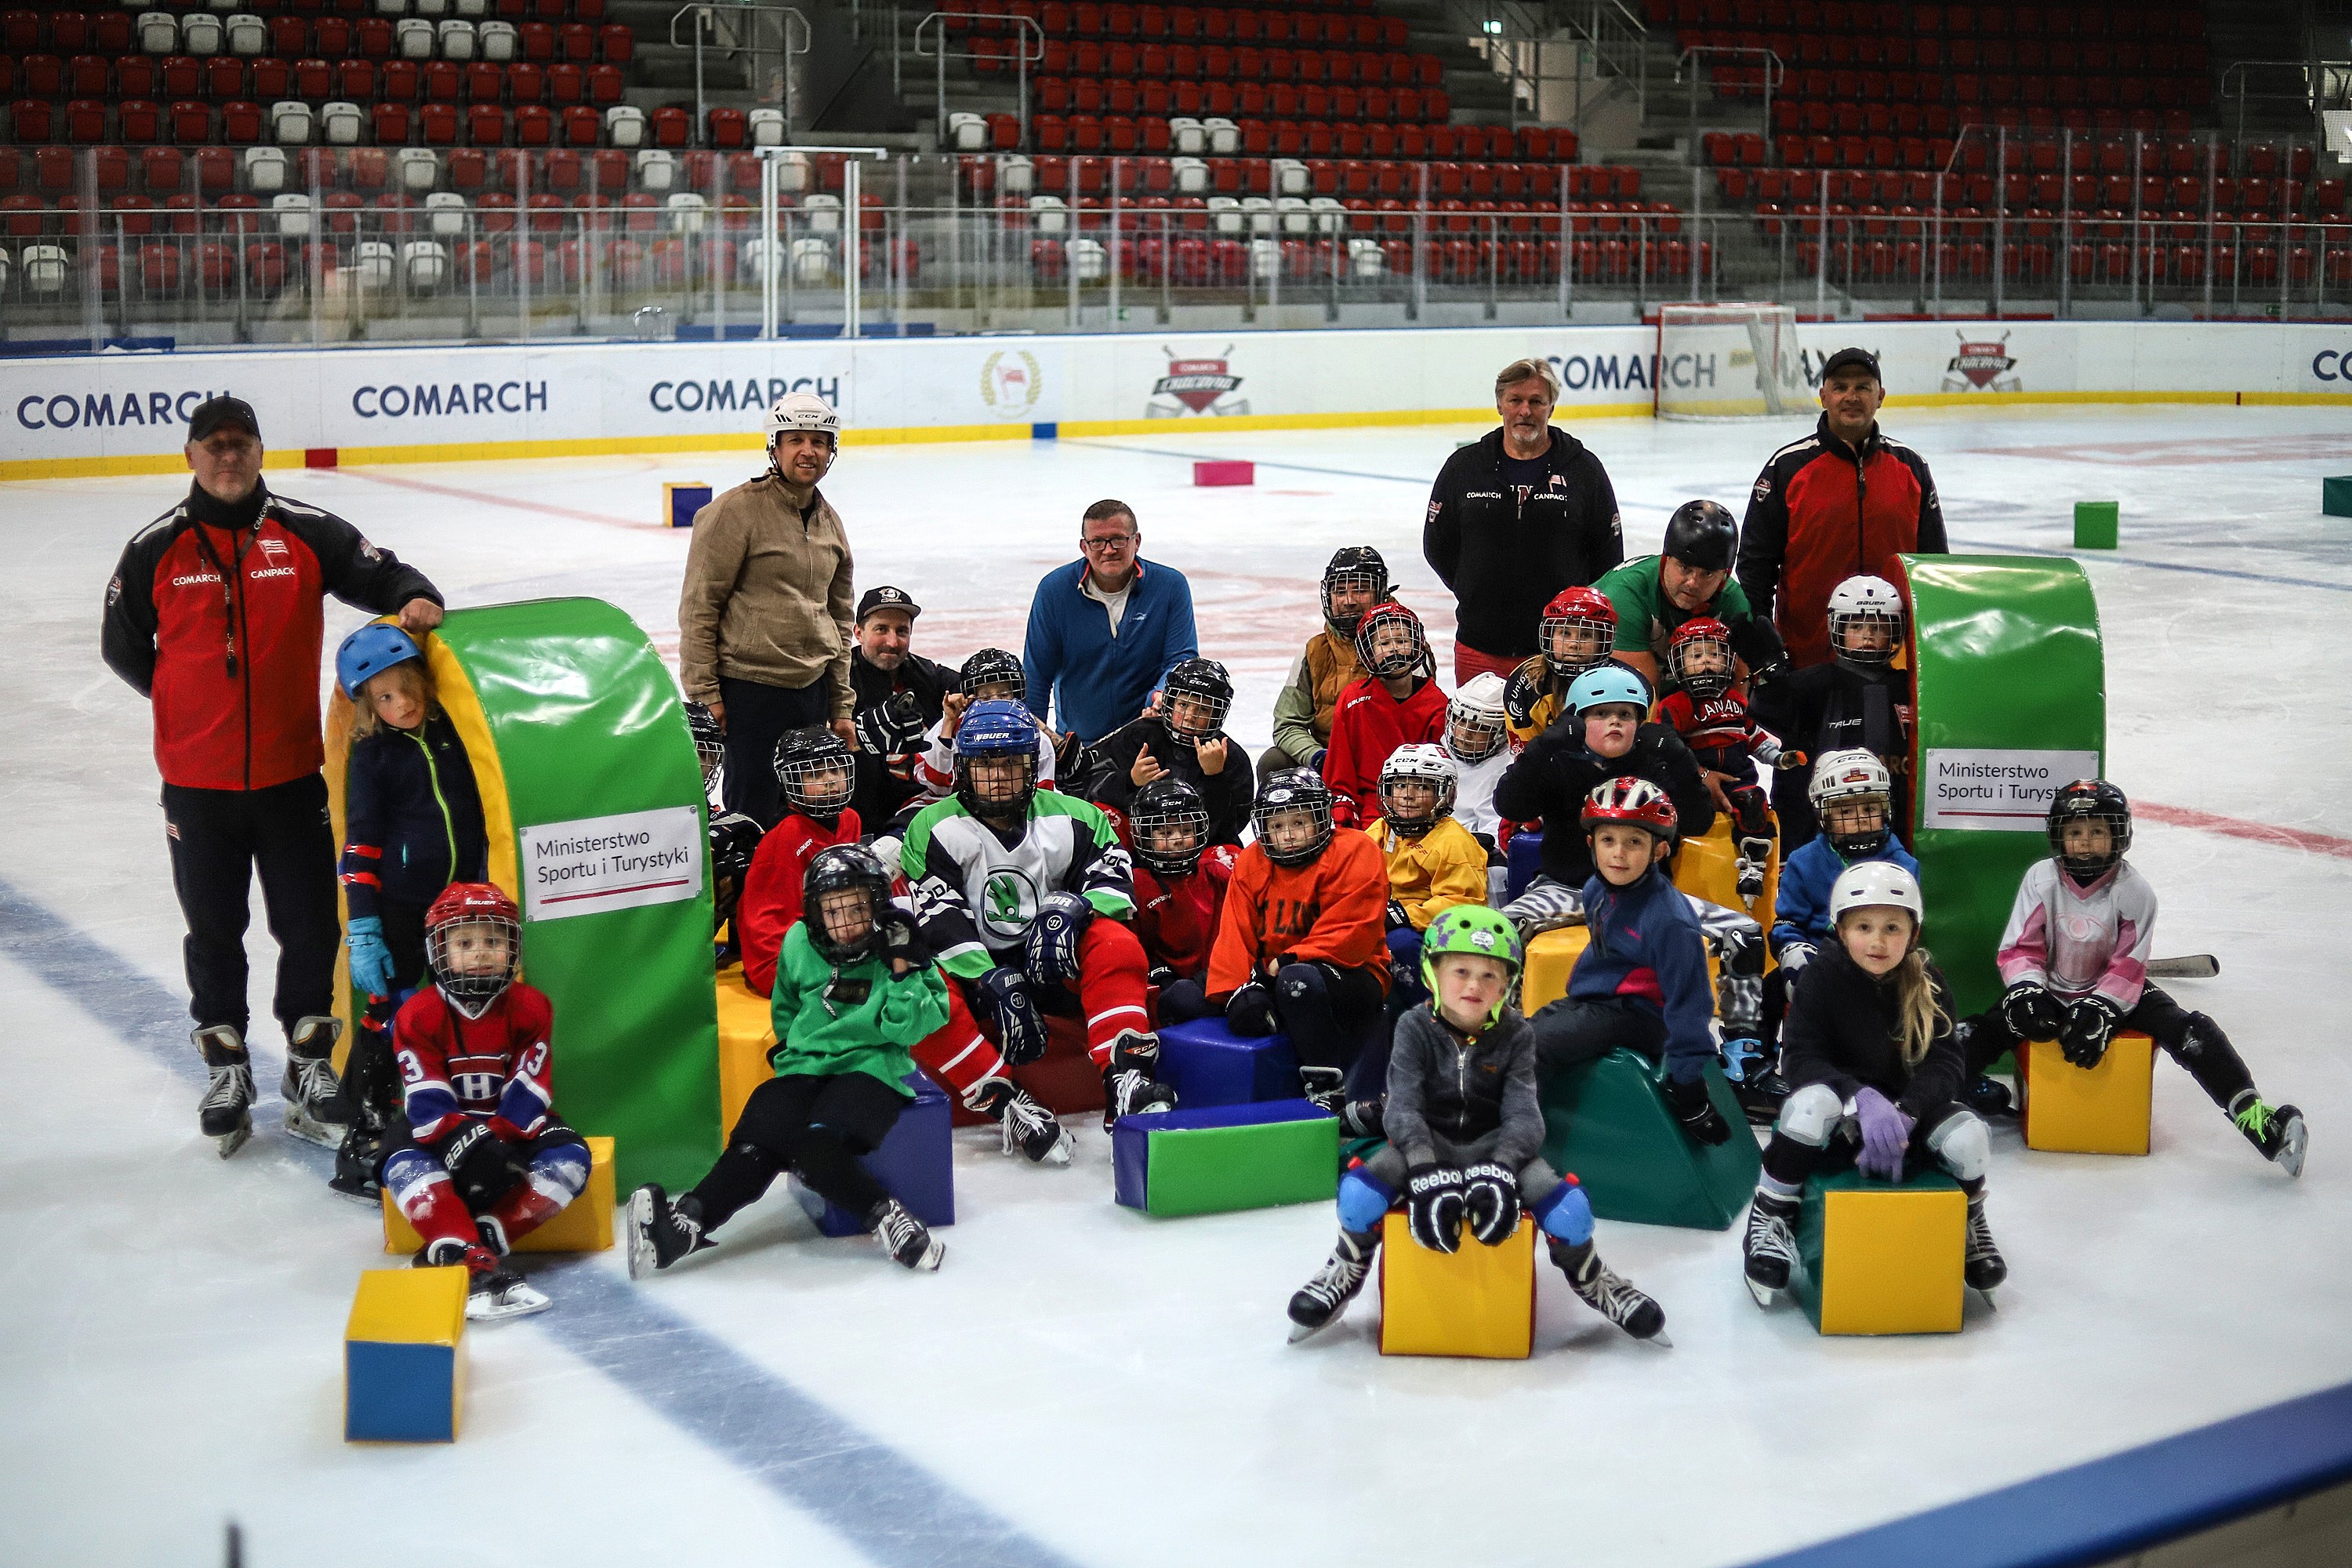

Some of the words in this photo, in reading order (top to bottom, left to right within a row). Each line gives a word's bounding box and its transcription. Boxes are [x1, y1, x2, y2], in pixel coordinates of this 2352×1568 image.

[353, 381, 546, 417] COMARCH
[17, 390, 230, 429] COMARC
[172, 574, 220, 586] COMARCH
[250, 567, 296, 579] CANPACK
[1189, 679, 1210, 688] CCM
[1460, 702, 1482, 713] BAUER
[1828, 719, 1863, 729] TRUE
[813, 743, 837, 753] BAUER
[1837, 756, 1867, 764] CCM
[1939, 762, 2049, 779] Ministerstwo
[1937, 783, 1993, 800] Sportu
[1999, 784, 2003, 799] i
[536, 831, 650, 859] Ministerstwo
[795, 838, 814, 857] BAUER
[538, 861, 597, 885] Sportu
[602, 858, 606, 874] i
[611, 846, 689, 873] Turystyki
[2002, 986, 2044, 1010] CCM
[1133, 1041, 1156, 1055] CCM
[397, 1050, 424, 1082] 3
